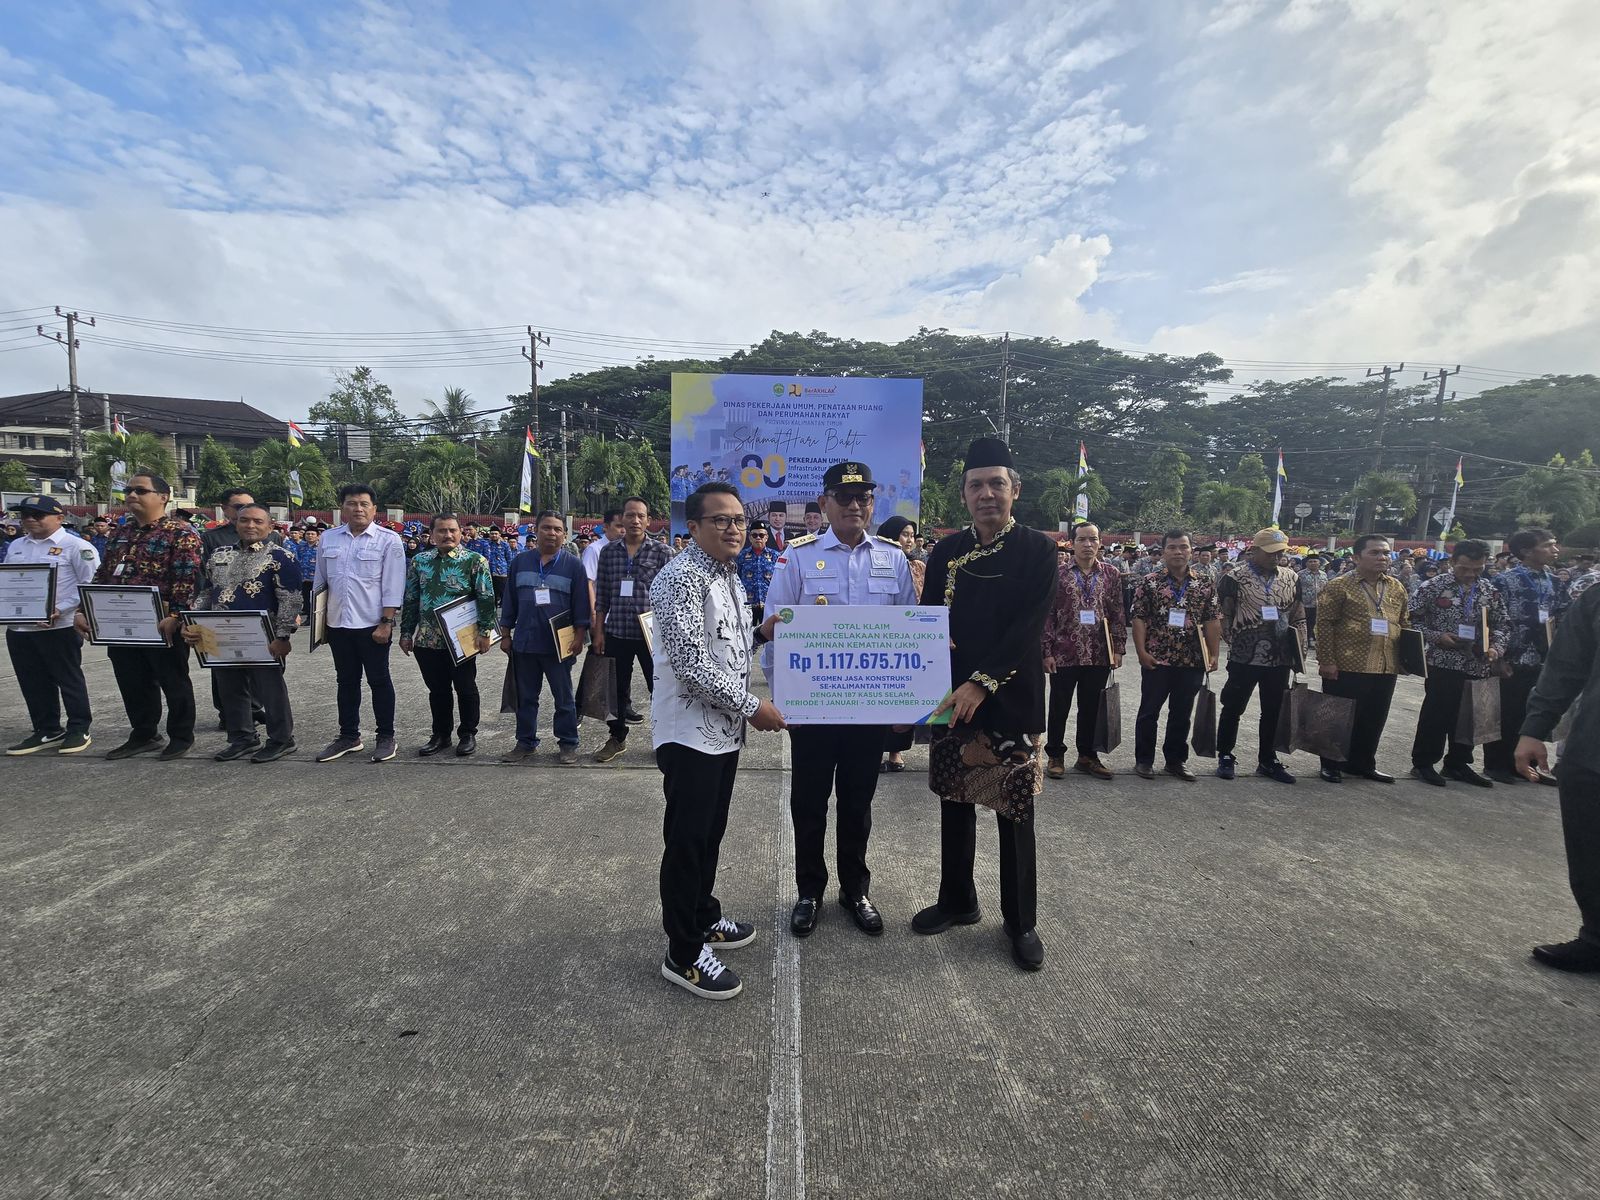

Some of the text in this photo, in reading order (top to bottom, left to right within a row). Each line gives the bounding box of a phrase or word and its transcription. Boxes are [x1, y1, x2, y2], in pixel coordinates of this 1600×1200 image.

[747, 401, 791, 409] PEKERJAAN
[818, 403, 856, 411] PENATAAN
[733, 426, 867, 455] Selamat Hari Bakti
[740, 454, 787, 489] 80
[912, 632, 936, 640] (JKK)
[894, 641, 919, 649] (JKM)
[789, 653, 934, 672] Rp 1.117.675.710,-
